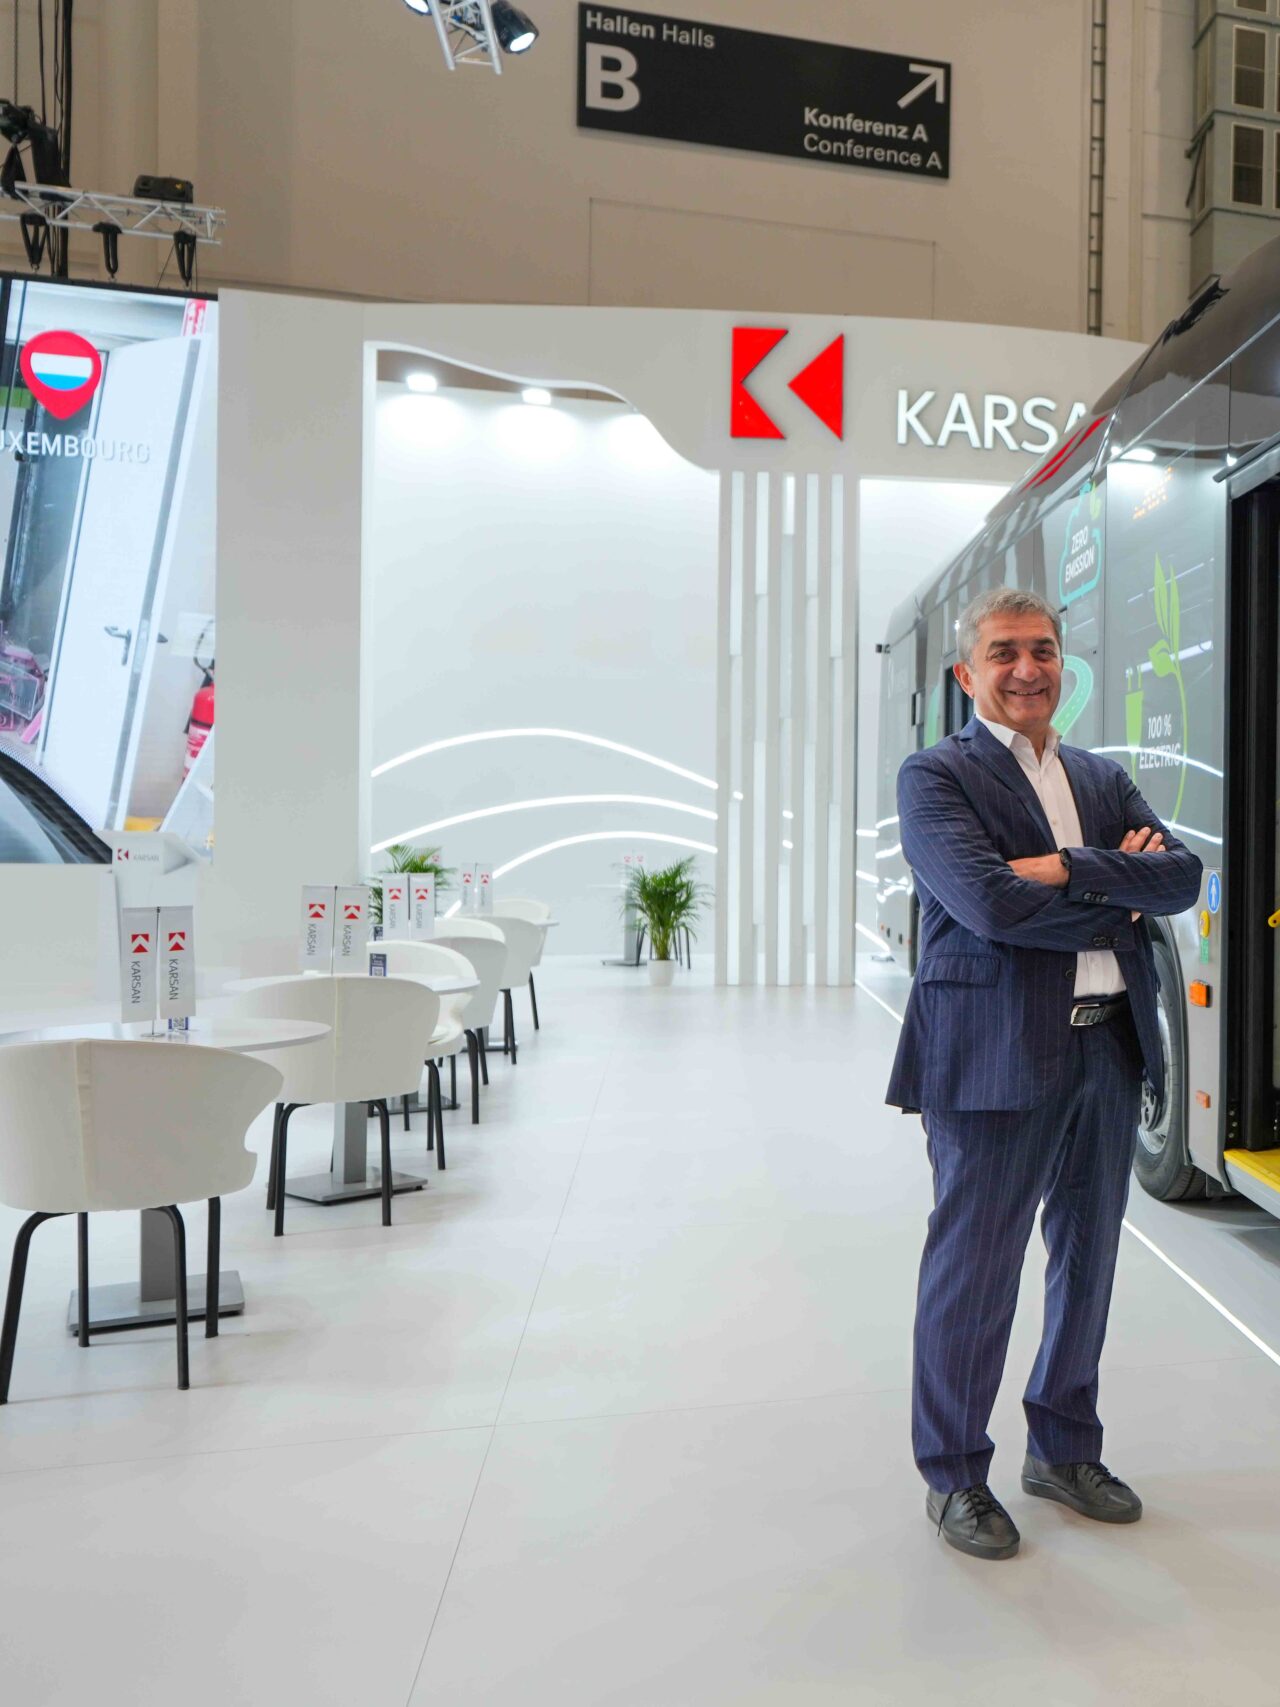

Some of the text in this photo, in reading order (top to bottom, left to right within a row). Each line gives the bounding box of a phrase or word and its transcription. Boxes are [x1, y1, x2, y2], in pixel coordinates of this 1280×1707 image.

[586, 10, 716, 49] Hallen Halls
[585, 42, 641, 112] B
[804, 106, 928, 143] Konferenz A
[803, 133, 943, 170] Conference A
[1071, 525, 1088, 554] ZERO
[1065, 544, 1095, 583] EMISSION
[1148, 713, 1172, 740] 100 %
[1139, 742, 1181, 769] ELECTRIC
[306, 923, 317, 956] KARSAN
[342, 924, 352, 957] KARSAN
[131, 961, 141, 1004] KARSAN
[169, 958, 179, 1001] KARSAN
